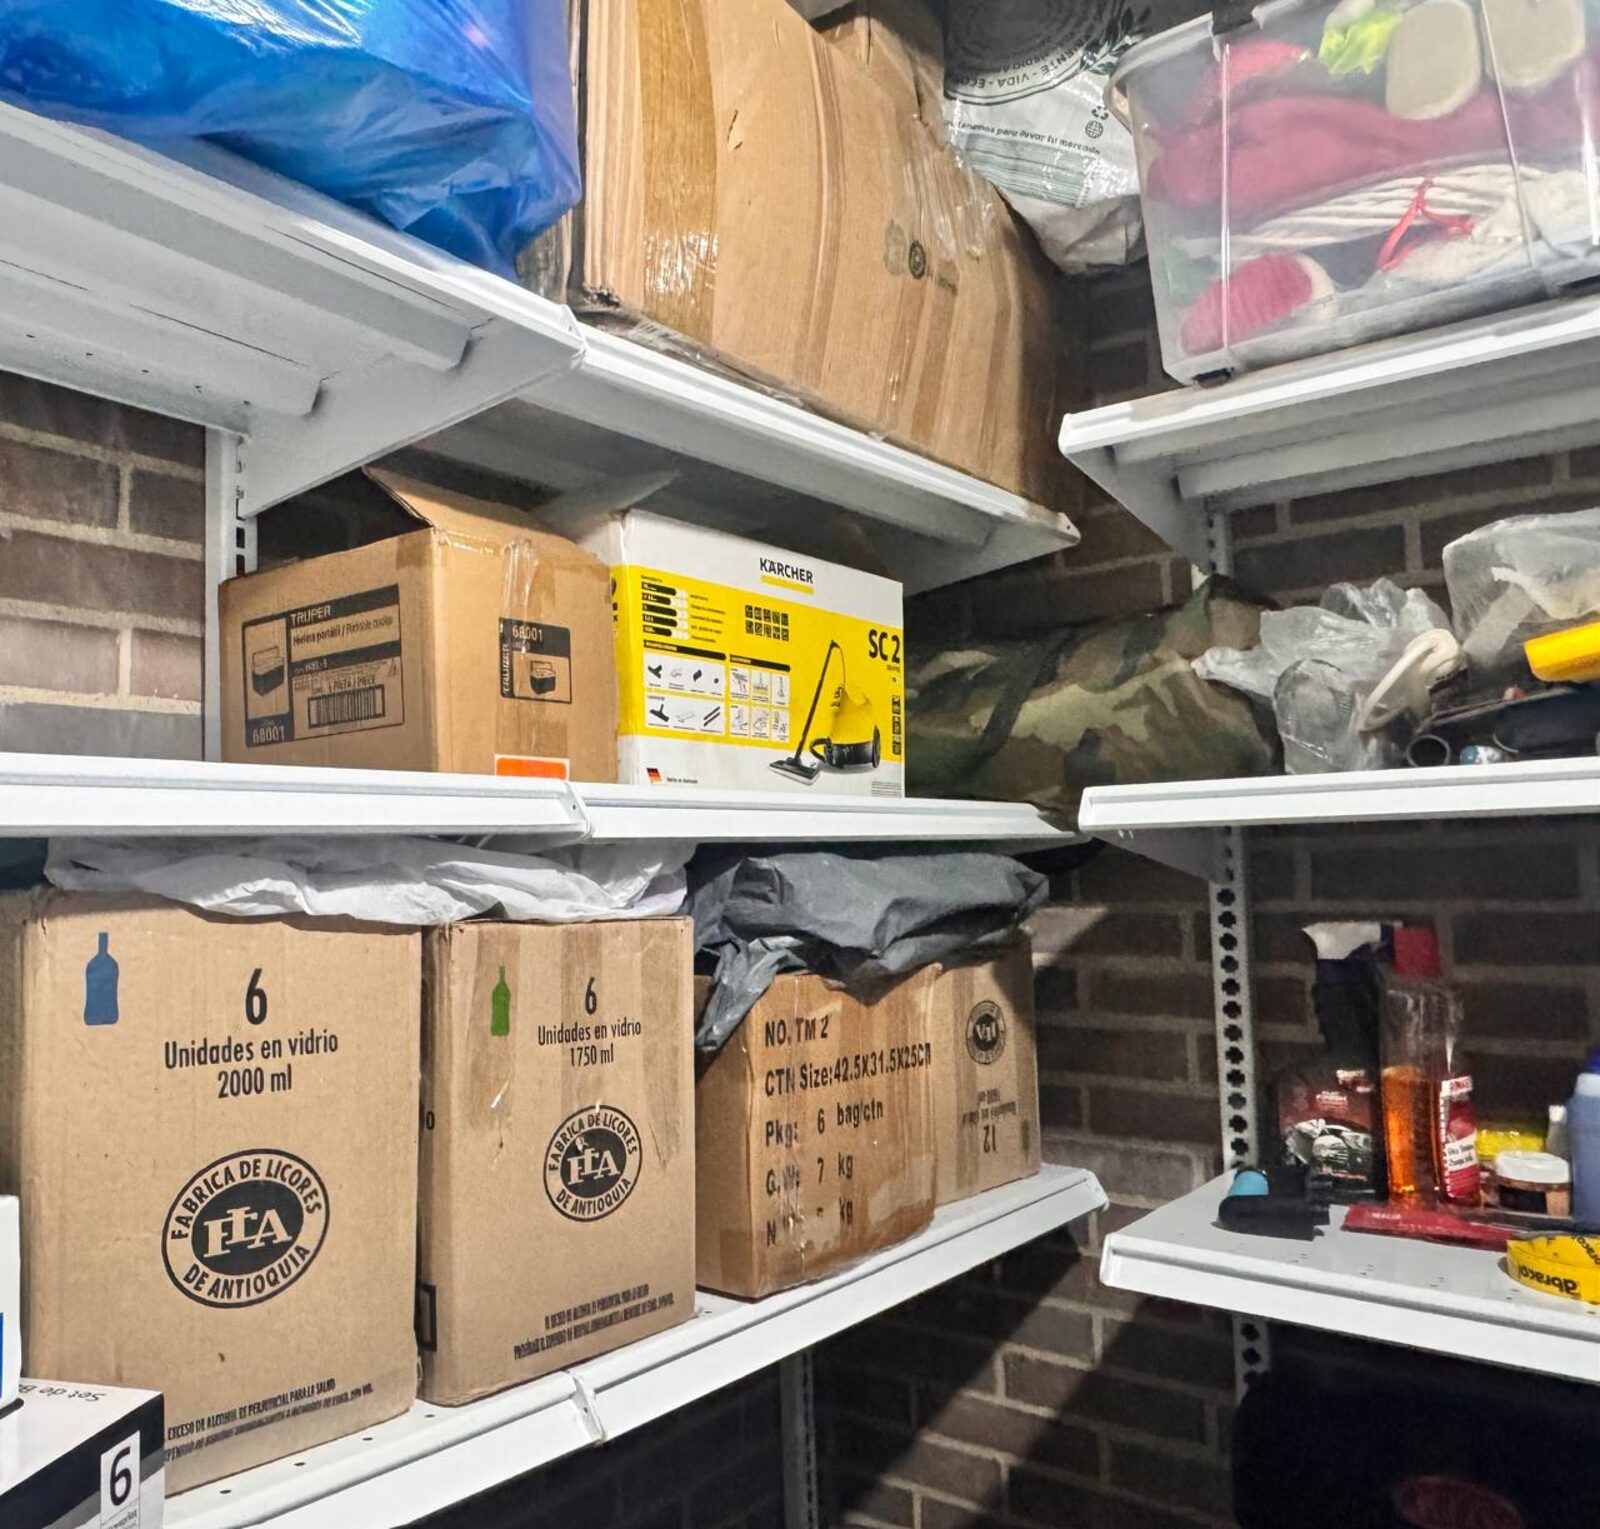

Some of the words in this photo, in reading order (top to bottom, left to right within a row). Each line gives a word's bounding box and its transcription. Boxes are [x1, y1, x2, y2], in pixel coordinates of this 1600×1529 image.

[997, 74, 1030, 89] VIDA
[290, 604, 332, 627] TRUPER
[512, 625, 543, 642] 68001
[868, 628, 888, 662] SC
[891, 634, 901, 665] 2
[252, 726, 286, 744] 68001
[245, 967, 268, 1025] 6
[584, 976, 598, 1016] 6
[538, 1020, 592, 1046] Unidades
[594, 1024, 608, 1040] en
[610, 1016, 642, 1038] vidrio
[820, 1015, 830, 1039] 2
[164, 1035, 255, 1069] Unidades
[260, 1038, 283, 1060] en
[288, 1028, 339, 1056] vidrio
[570, 1044, 598, 1068] 1750
[600, 1041, 615, 1065] ml
[217, 1067, 265, 1099] 2000
[270, 1063, 293, 1093] ml
[764, 1068, 796, 1097] CTN
[817, 1107, 826, 1135] 6
[548, 1117, 586, 1172] FABRICA
[587, 1112, 601, 1128] DE
[602, 1112, 638, 1156] LICORES
[816, 1156, 825, 1185] 7
[837, 1151, 854, 1179] kg
[170, 1165, 236, 1241] FABRICA
[239, 1158, 263, 1180] DE
[265, 1158, 322, 1215] LICORES
[555, 1188, 572, 1210] DE
[570, 1177, 632, 1216] ANTIOQUIA
[203, 1205, 293, 1259] FLA
[182, 1263, 210, 1292] DE
[207, 1244, 311, 1300] ANTIOQUIA
[39, 1385, 68, 1399] de
[167, 1421, 195, 1441] EXCESO
[110, 1445, 132, 1507] 6
